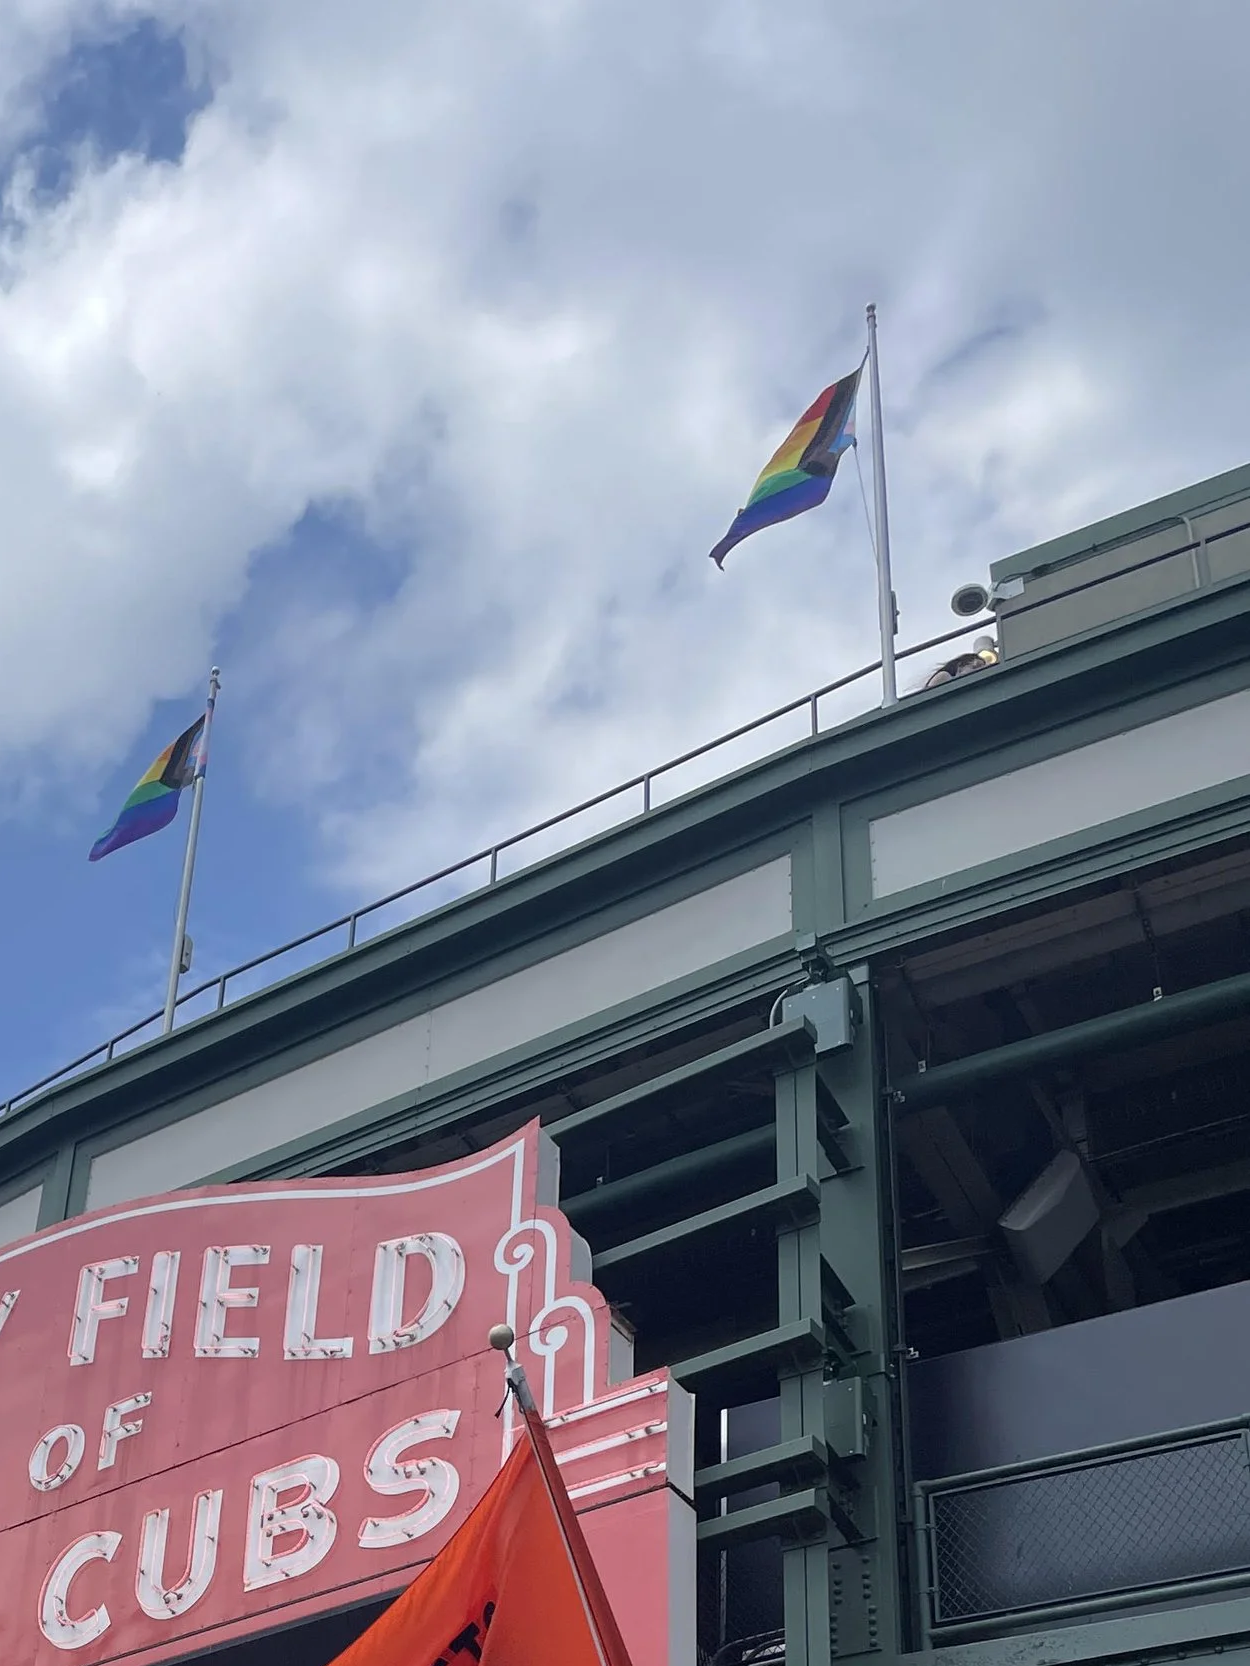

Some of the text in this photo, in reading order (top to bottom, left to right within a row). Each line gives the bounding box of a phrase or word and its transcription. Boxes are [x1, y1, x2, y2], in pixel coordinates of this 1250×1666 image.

[68, 1232, 466, 1366] FIELD
[29, 1391, 152, 1491] OF
[38, 1408, 461, 1650] CUBS
